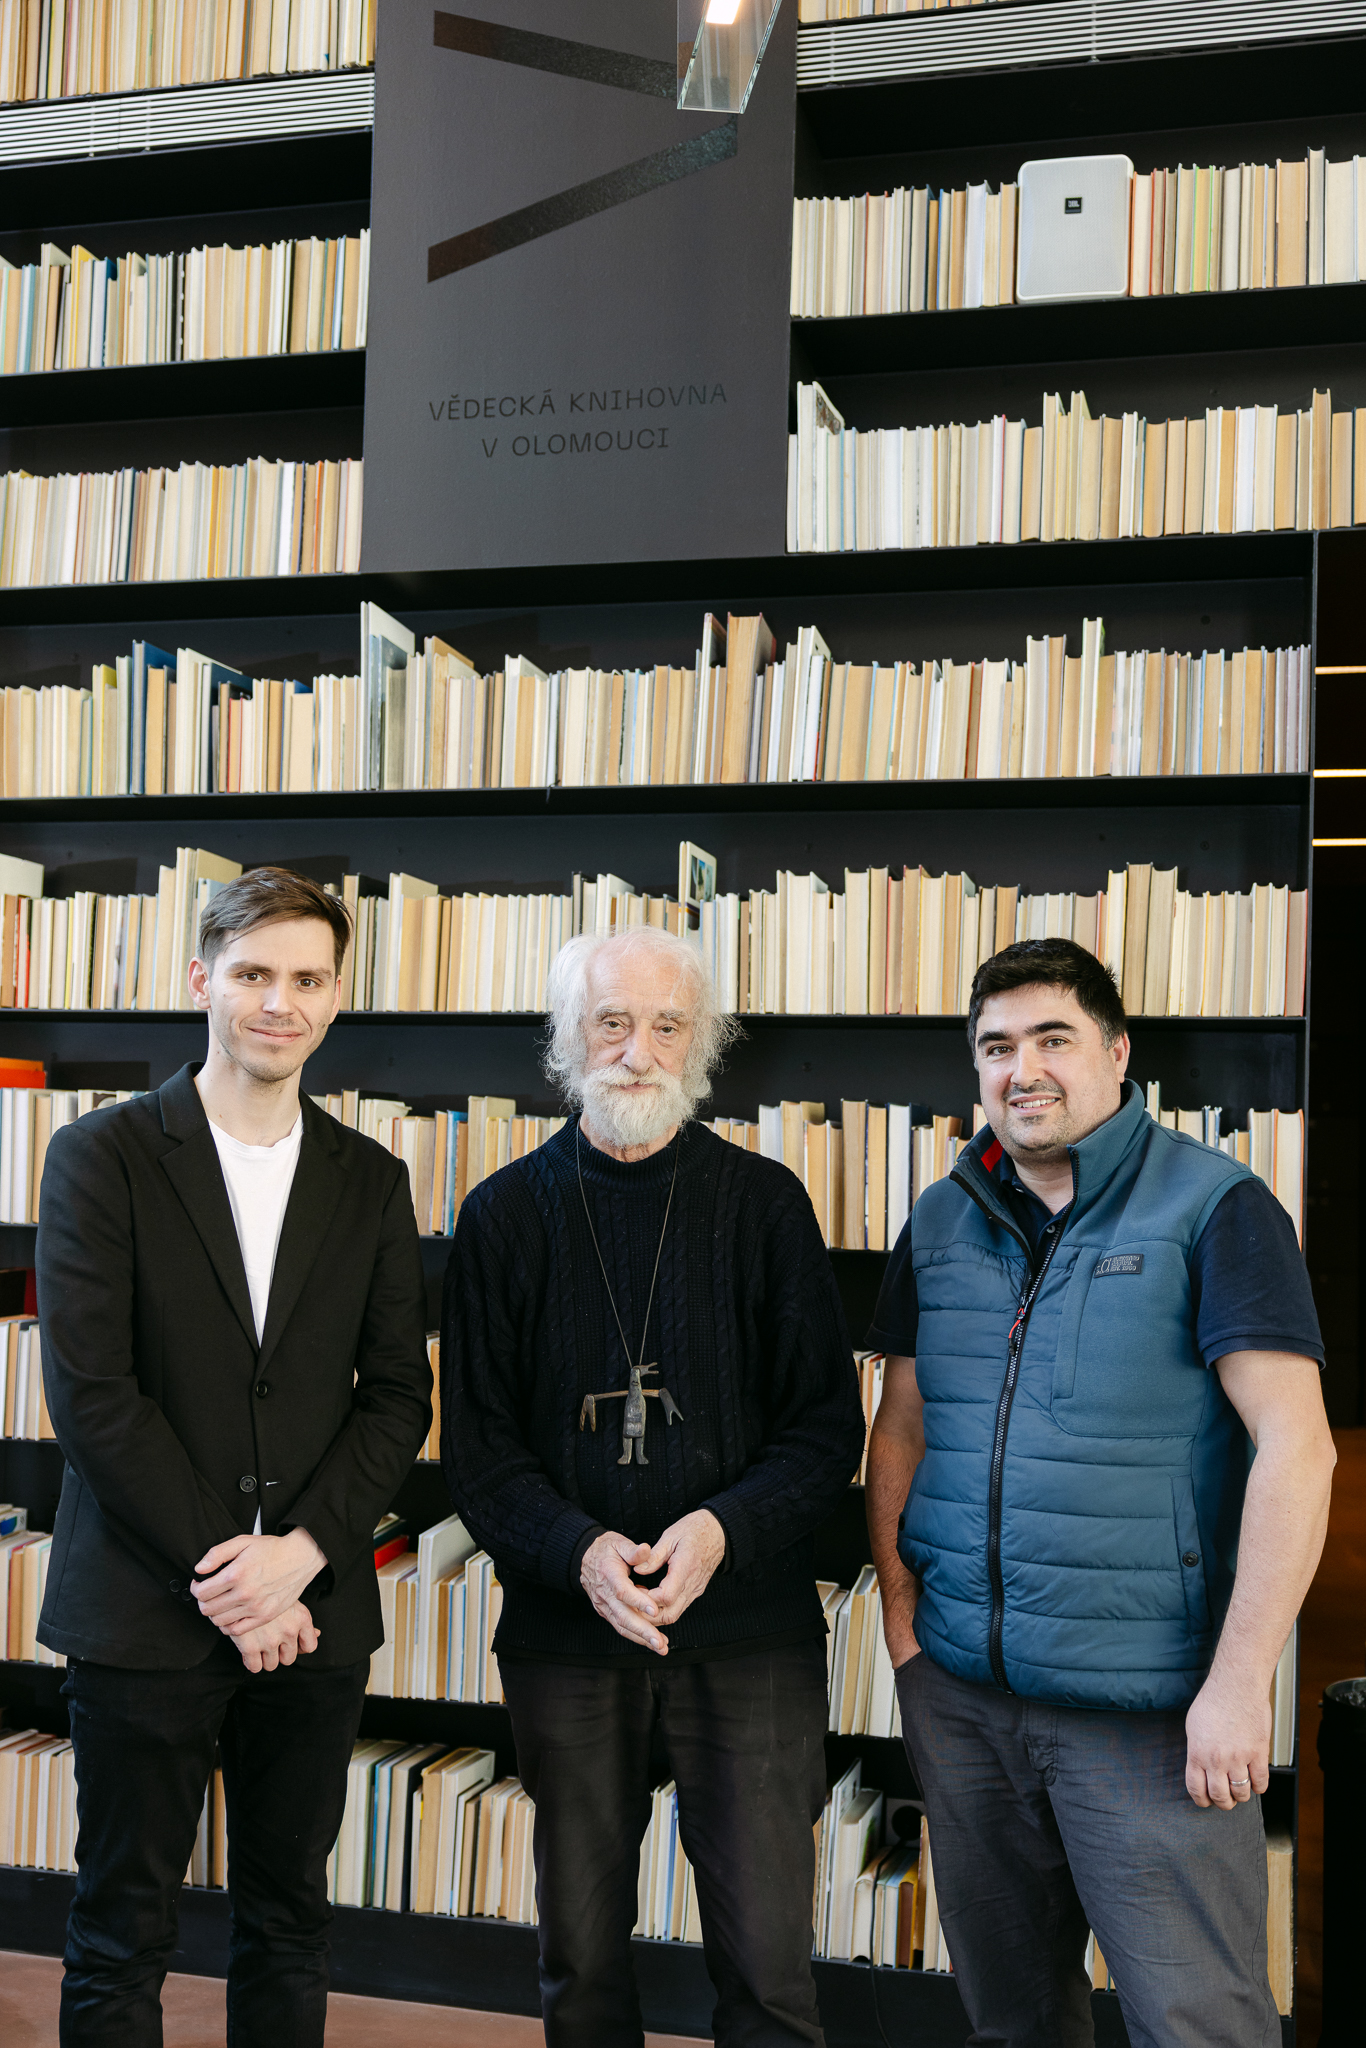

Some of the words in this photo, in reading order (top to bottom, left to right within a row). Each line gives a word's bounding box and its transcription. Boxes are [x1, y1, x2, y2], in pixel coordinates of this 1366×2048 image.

[429, 388, 556, 421] VĚDECKÁ
[569, 383, 728, 413] KNIHOVNA
[481, 437, 499, 459] V
[512, 428, 669, 456] OLOMOUCI
